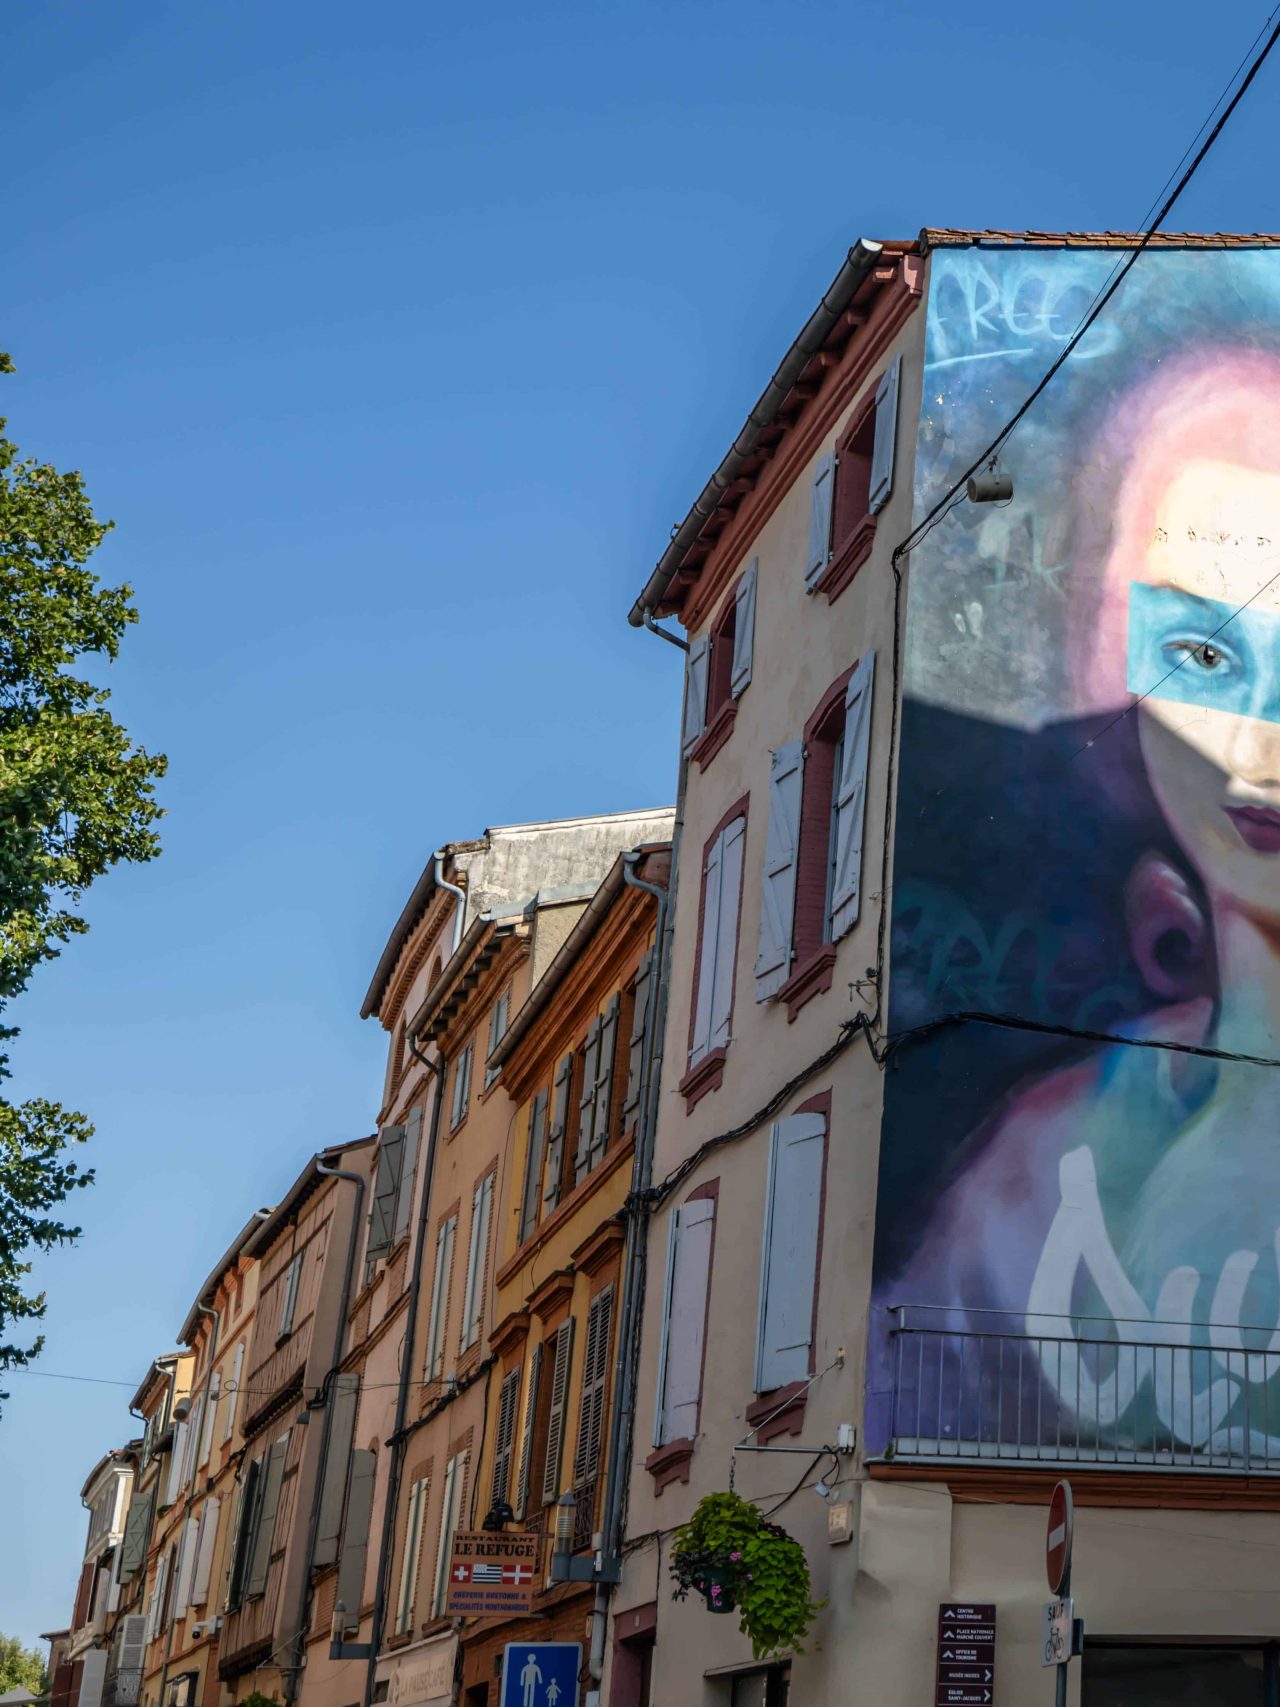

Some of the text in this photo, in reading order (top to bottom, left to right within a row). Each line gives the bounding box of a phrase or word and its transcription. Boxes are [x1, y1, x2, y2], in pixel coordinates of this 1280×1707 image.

[455, 1543, 534, 1557] LE REFUGE
[1048, 1603, 1064, 1621] SAUF
